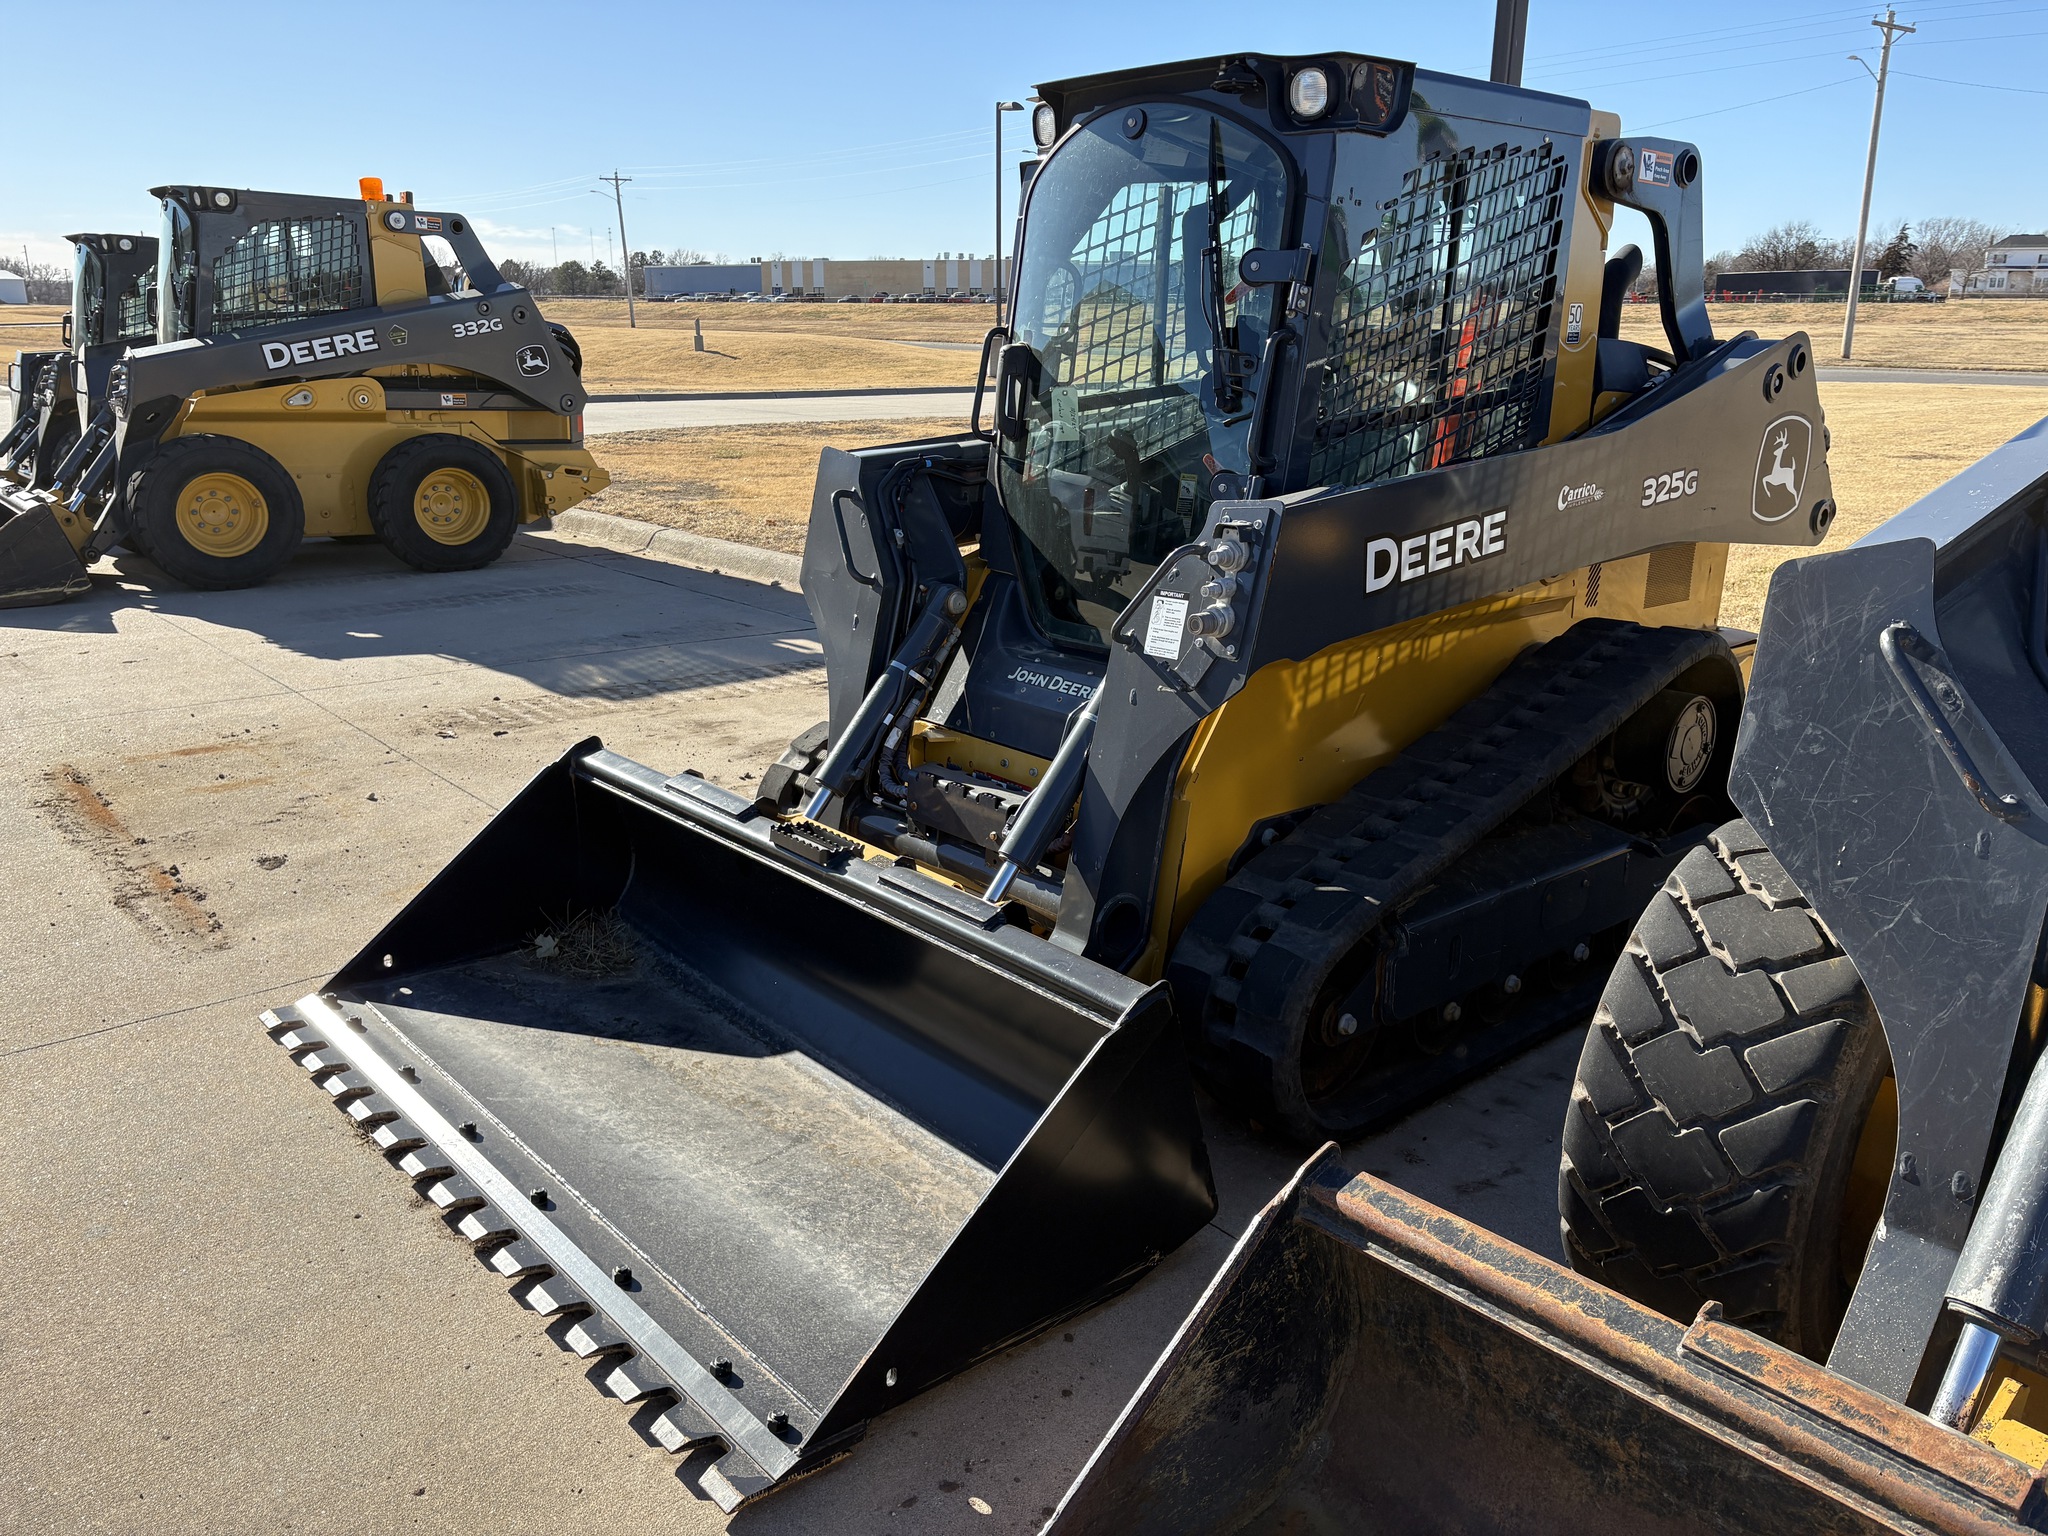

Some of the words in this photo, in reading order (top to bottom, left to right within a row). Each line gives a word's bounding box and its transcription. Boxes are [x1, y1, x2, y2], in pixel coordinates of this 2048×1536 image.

[1569, 304, 1582, 324] 50
[452, 318, 503, 338] 332G
[262, 329, 379, 370] DEERE
[1557, 482, 1596, 511] Carrico
[1641, 470, 1698, 507] 325G
[1366, 511, 1506, 593] DEERE
[1160, 590, 1184, 599] IMPORTANT
[1007, 666, 1050, 688] JOHN
